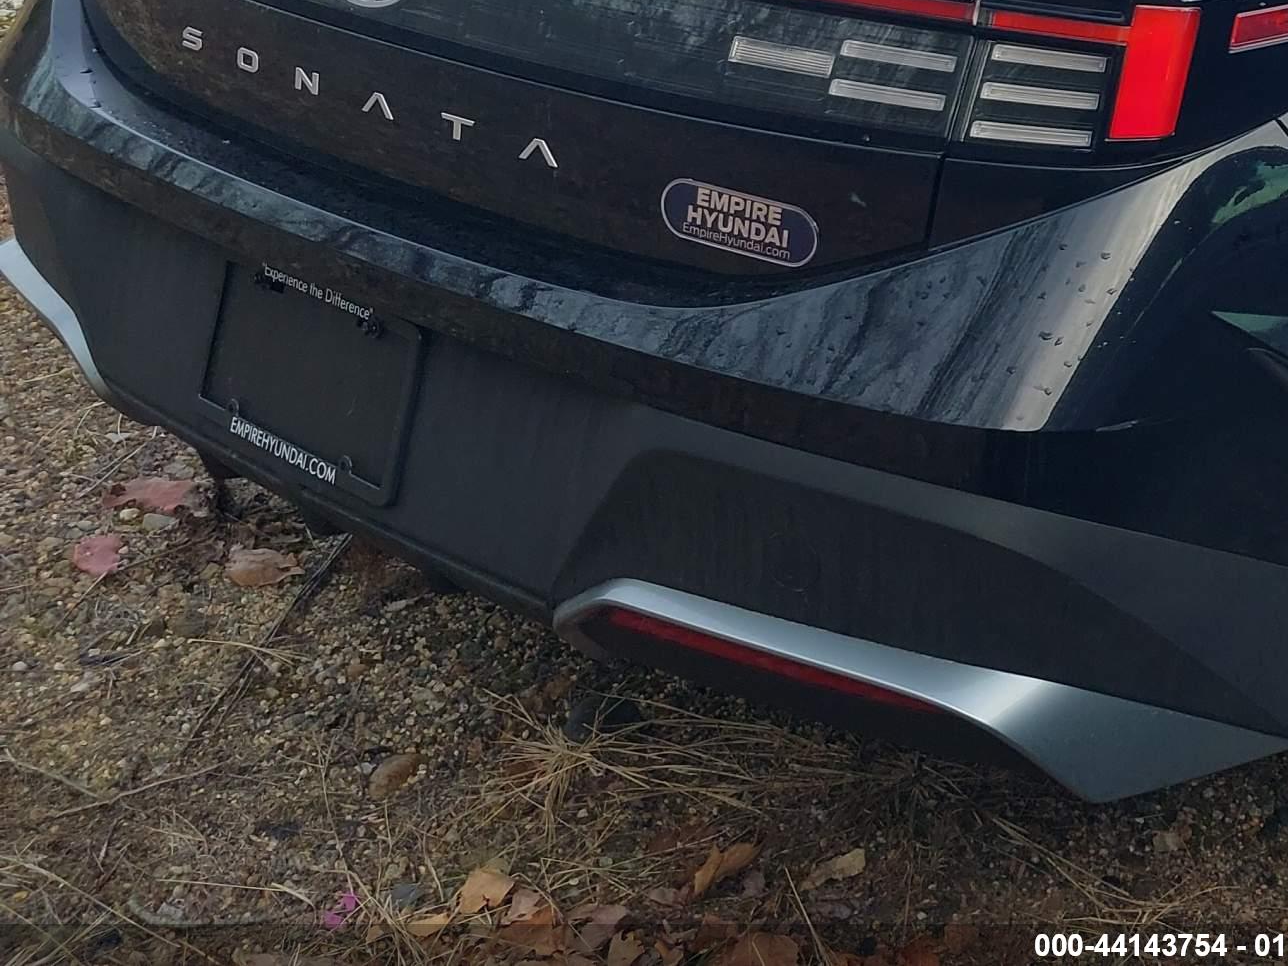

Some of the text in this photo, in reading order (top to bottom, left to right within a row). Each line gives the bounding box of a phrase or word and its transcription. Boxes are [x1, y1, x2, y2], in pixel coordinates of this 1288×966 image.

[181, 25, 559, 169] SONATA
[686, 205, 789, 248] HYUNDAI
[696, 186, 783, 226] EMPIRE
[682, 221, 791, 260] EmpireHyundai.com
[229, 416, 337, 485] EMPIREHYUNDAI.COM
